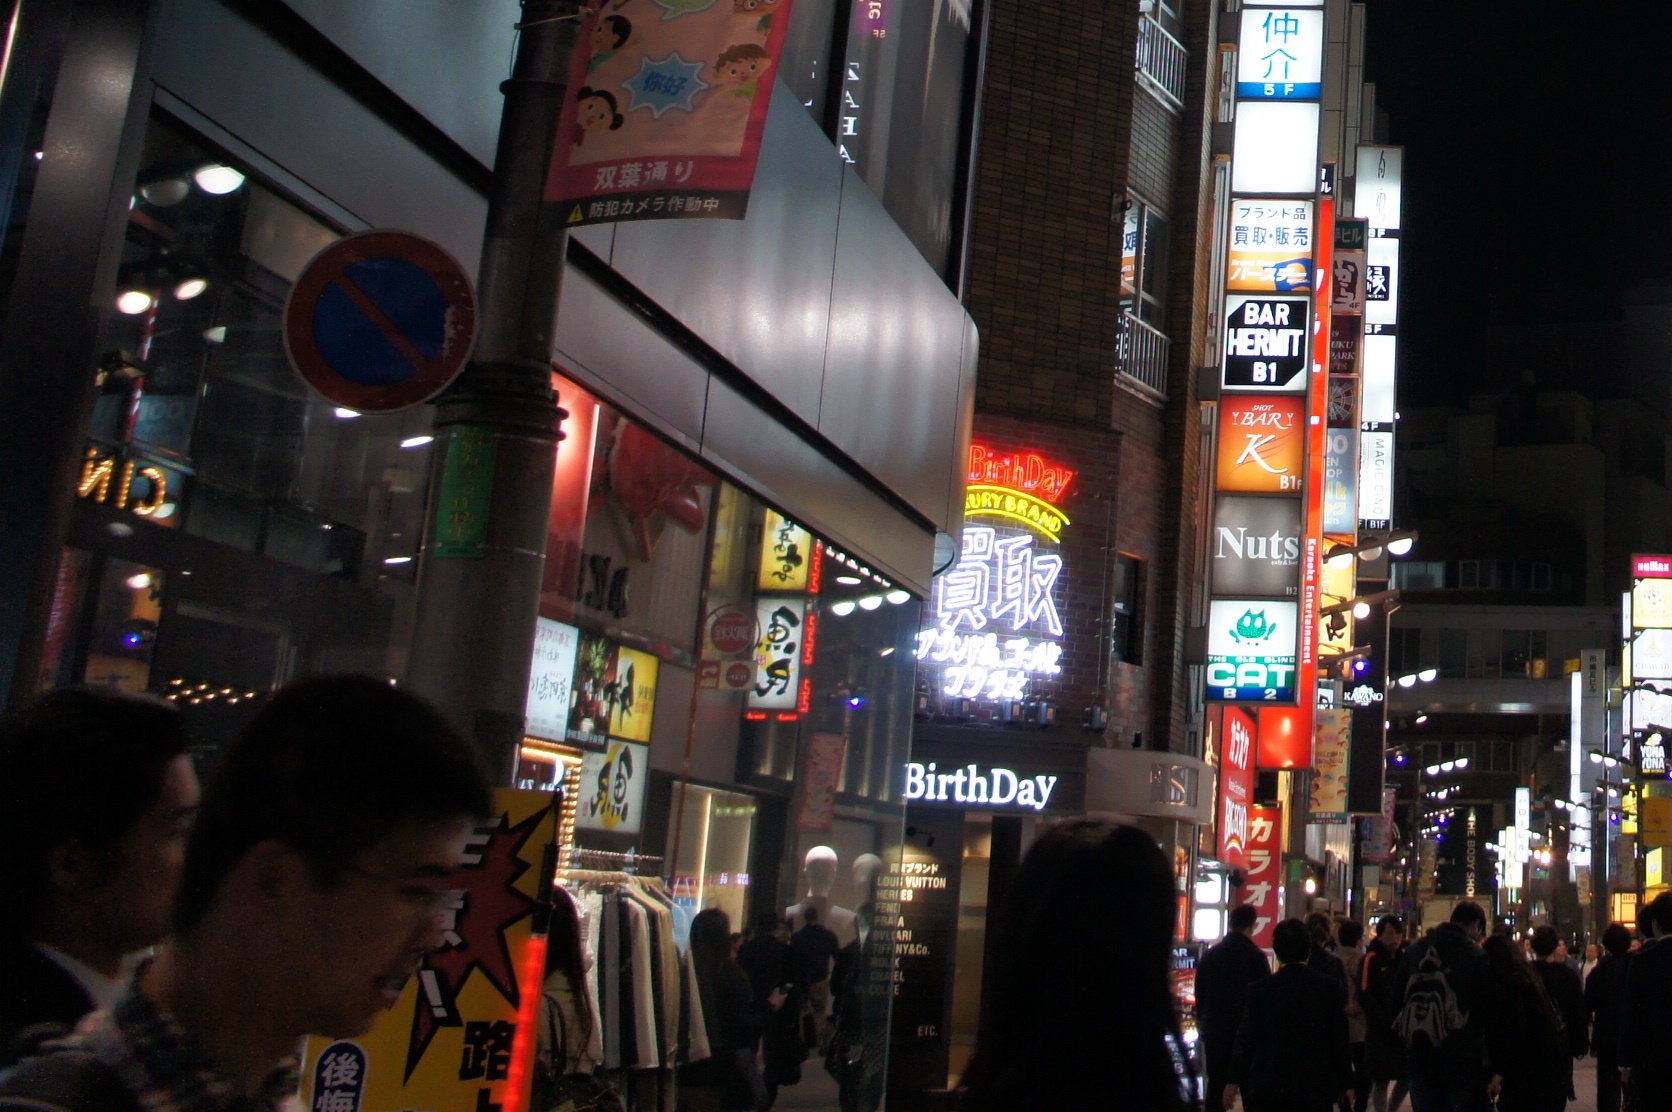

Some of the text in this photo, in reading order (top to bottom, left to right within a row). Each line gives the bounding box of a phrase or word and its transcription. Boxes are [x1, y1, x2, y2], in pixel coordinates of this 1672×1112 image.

[1261, 12, 1299, 80] 仲介
[642, 71, 688, 95] 你好
[1263, 84, 1295, 96] 5F
[593, 161, 695, 191] 双葉通り
[588, 196, 720, 220] 防犯カメラ作動中
[1239, 207, 1306, 220] ブランド品
[1244, 302, 1289, 326] BAR
[1349, 302, 1361, 310] 4F
[1365, 325, 1382, 334] 5F
[1227, 328, 1304, 358] HERMIT
[1252, 361, 1278, 383] B1
[1241, 411, 1289, 429] BAR
[1252, 404, 1275, 413] SHOT
[1361, 422, 1379, 431] 4F
[1236, 433, 1288, 474] K
[966, 443, 1077, 502] BirthDay
[1279, 474, 1303, 490] B1F
[1003, 495, 1062, 534] BRAND
[1369, 519, 1386, 530] B1F
[1214, 526, 1299, 560] Nuts
[936, 526, 1064, 637] 買取
[1286, 586, 1299, 596] B2
[1303, 538, 1317, 664] Karaoke Entertainment
[1207, 663, 1296, 688] CAT
[1640, 745, 1665, 758] YONA
[904, 761, 1058, 810] BirthDay
[905, 876, 947, 889] VUITTON
[1241, 816, 1273, 938] カラオケ
[917, 1025, 938, 1037] ETC.
